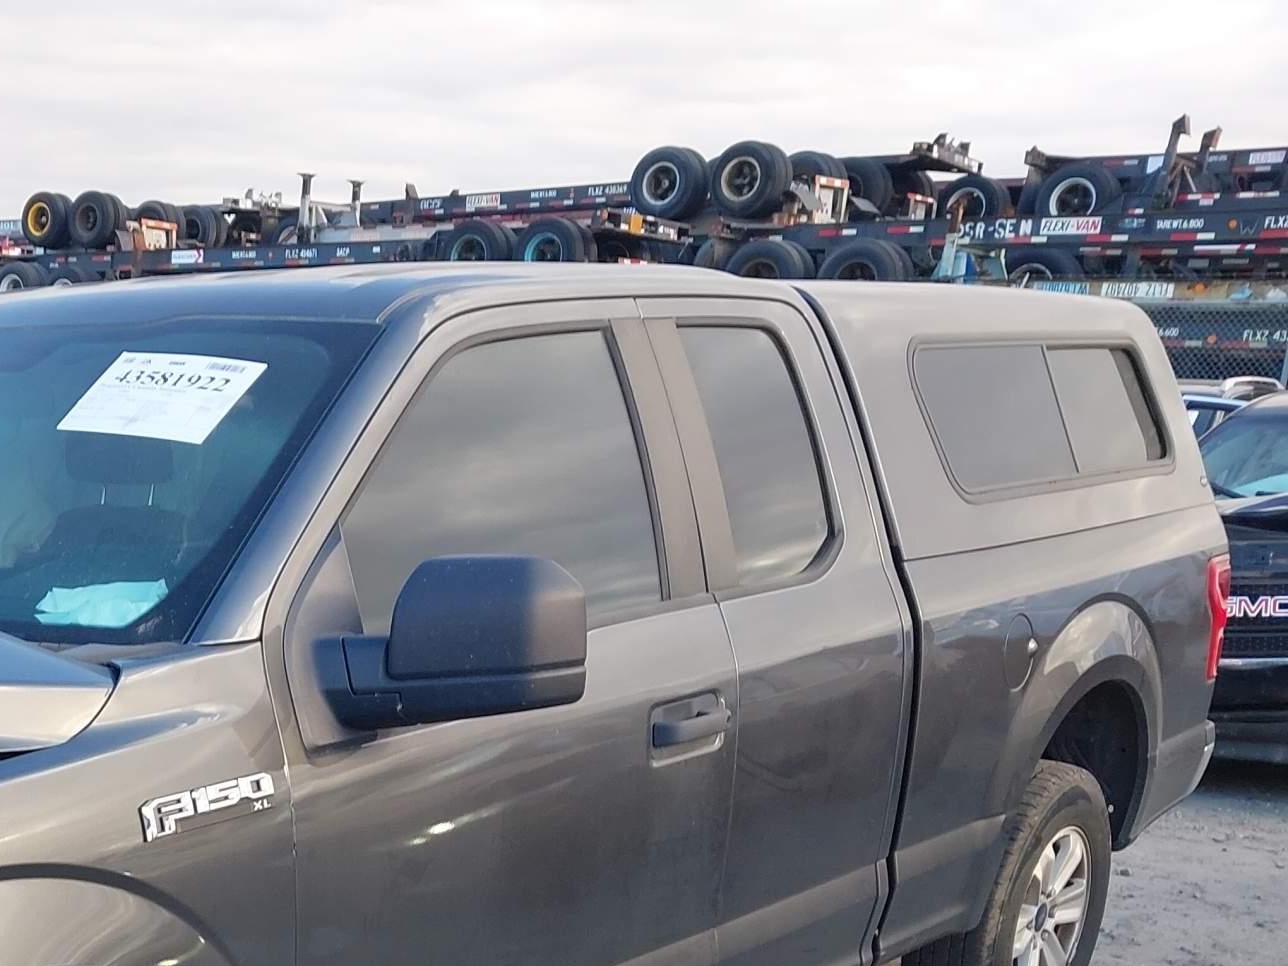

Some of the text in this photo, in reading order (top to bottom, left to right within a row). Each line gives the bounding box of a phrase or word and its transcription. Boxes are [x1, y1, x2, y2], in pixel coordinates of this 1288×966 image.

[1042, 218, 1100, 232] FLEXI-VAN
[114, 369, 232, 392] 43581922
[253, 798, 272, 811] XL
